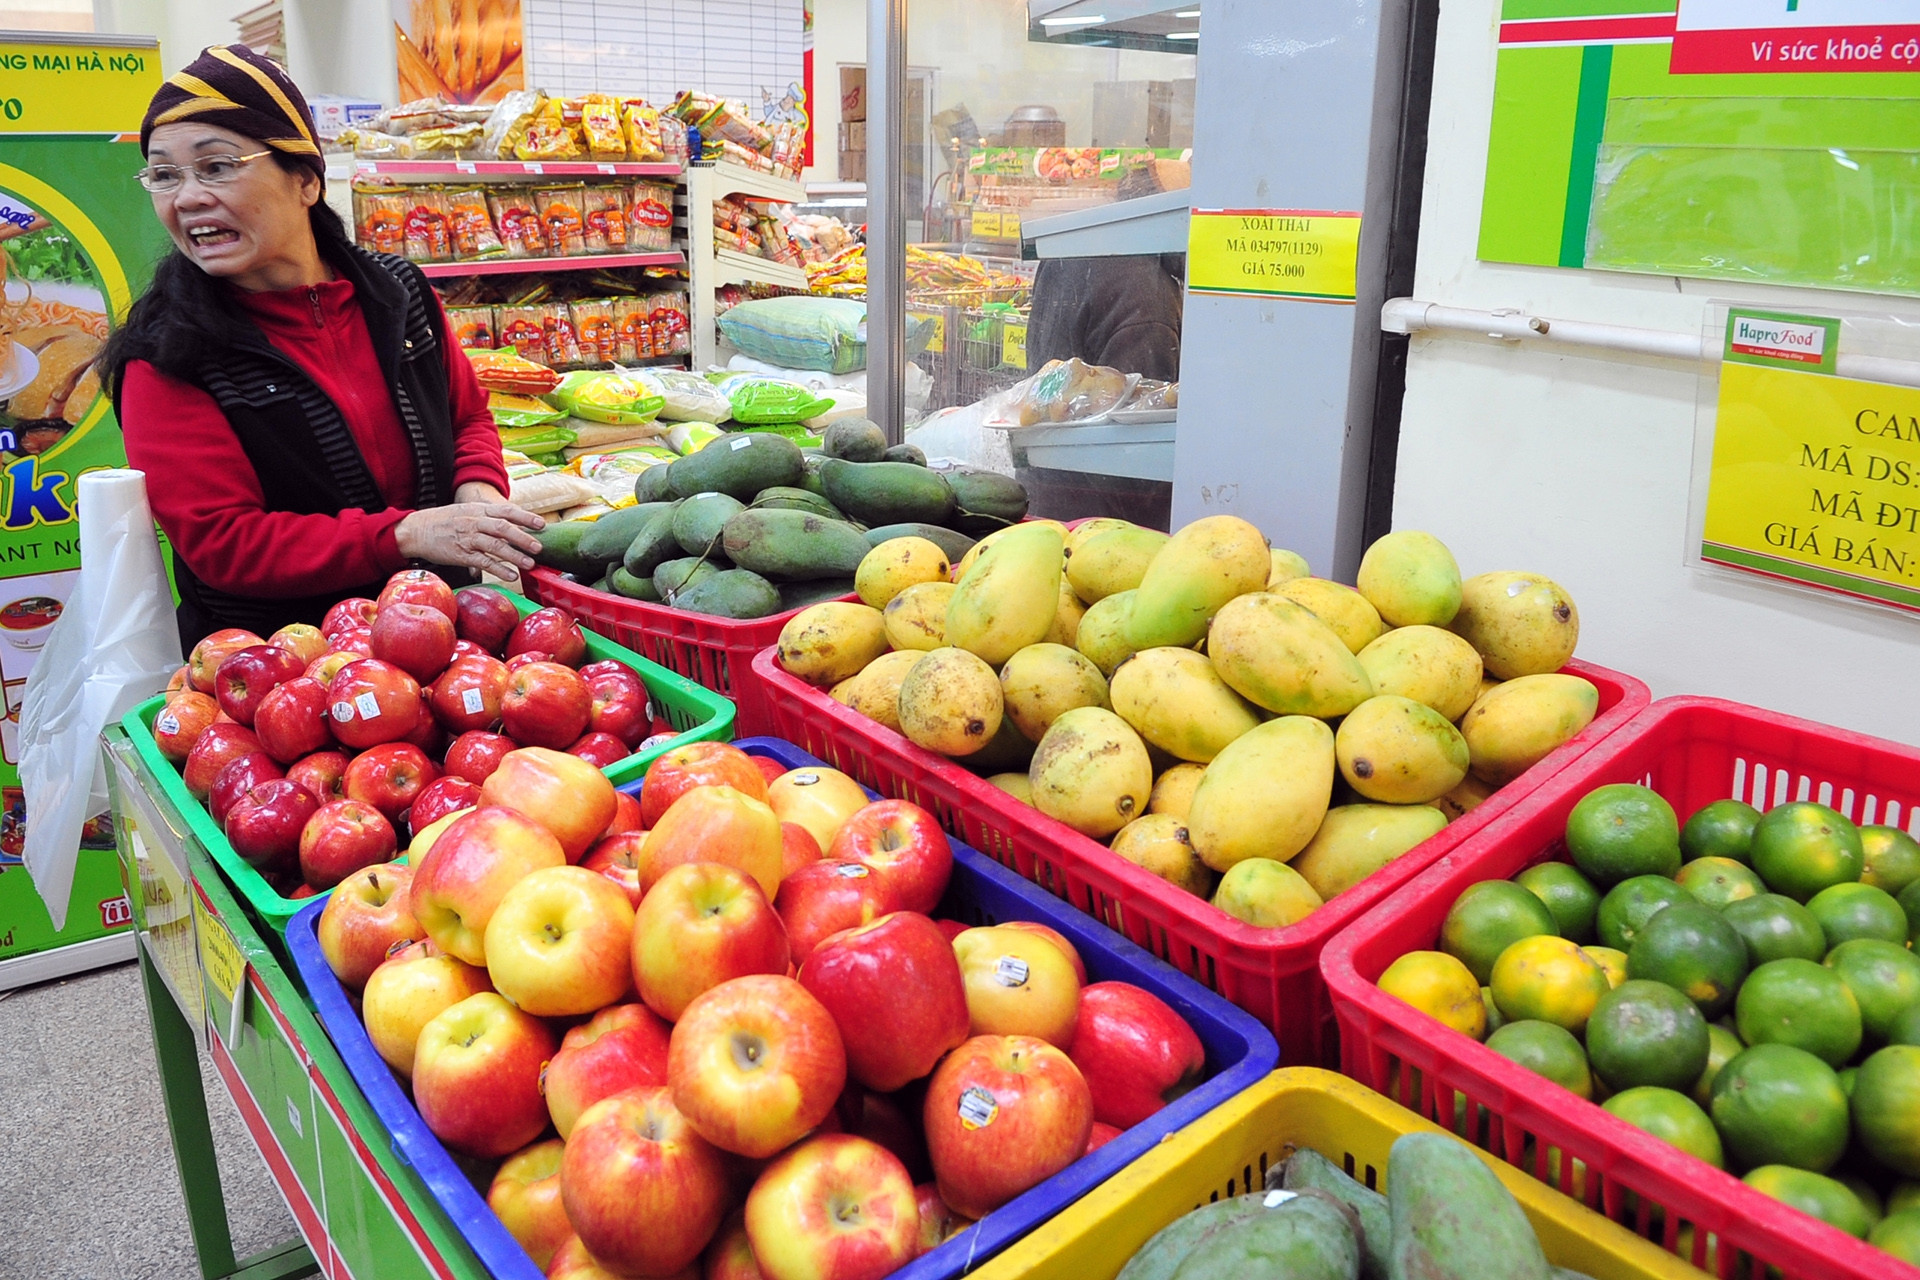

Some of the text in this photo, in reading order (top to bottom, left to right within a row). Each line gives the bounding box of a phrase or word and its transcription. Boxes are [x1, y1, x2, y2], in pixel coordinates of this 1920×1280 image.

[33, 54, 70, 74] MẠI
[76, 51, 104, 71] HÀ
[109, 53, 144, 75] NỘI
[1779, 40, 1819, 61] sức
[1825, 35, 1883, 60] khoẻ
[1890, 38, 1920, 65] cộ
[1226, 237, 1323, 256] MÃ 034797(1129)
[1242, 259, 1305, 278] GIÁ 75.000
[1799, 443, 1854, 476] MÃ
[1809, 488, 1864, 522] MÃ
[1764, 522, 1916, 578] GIÁ BÁN:
